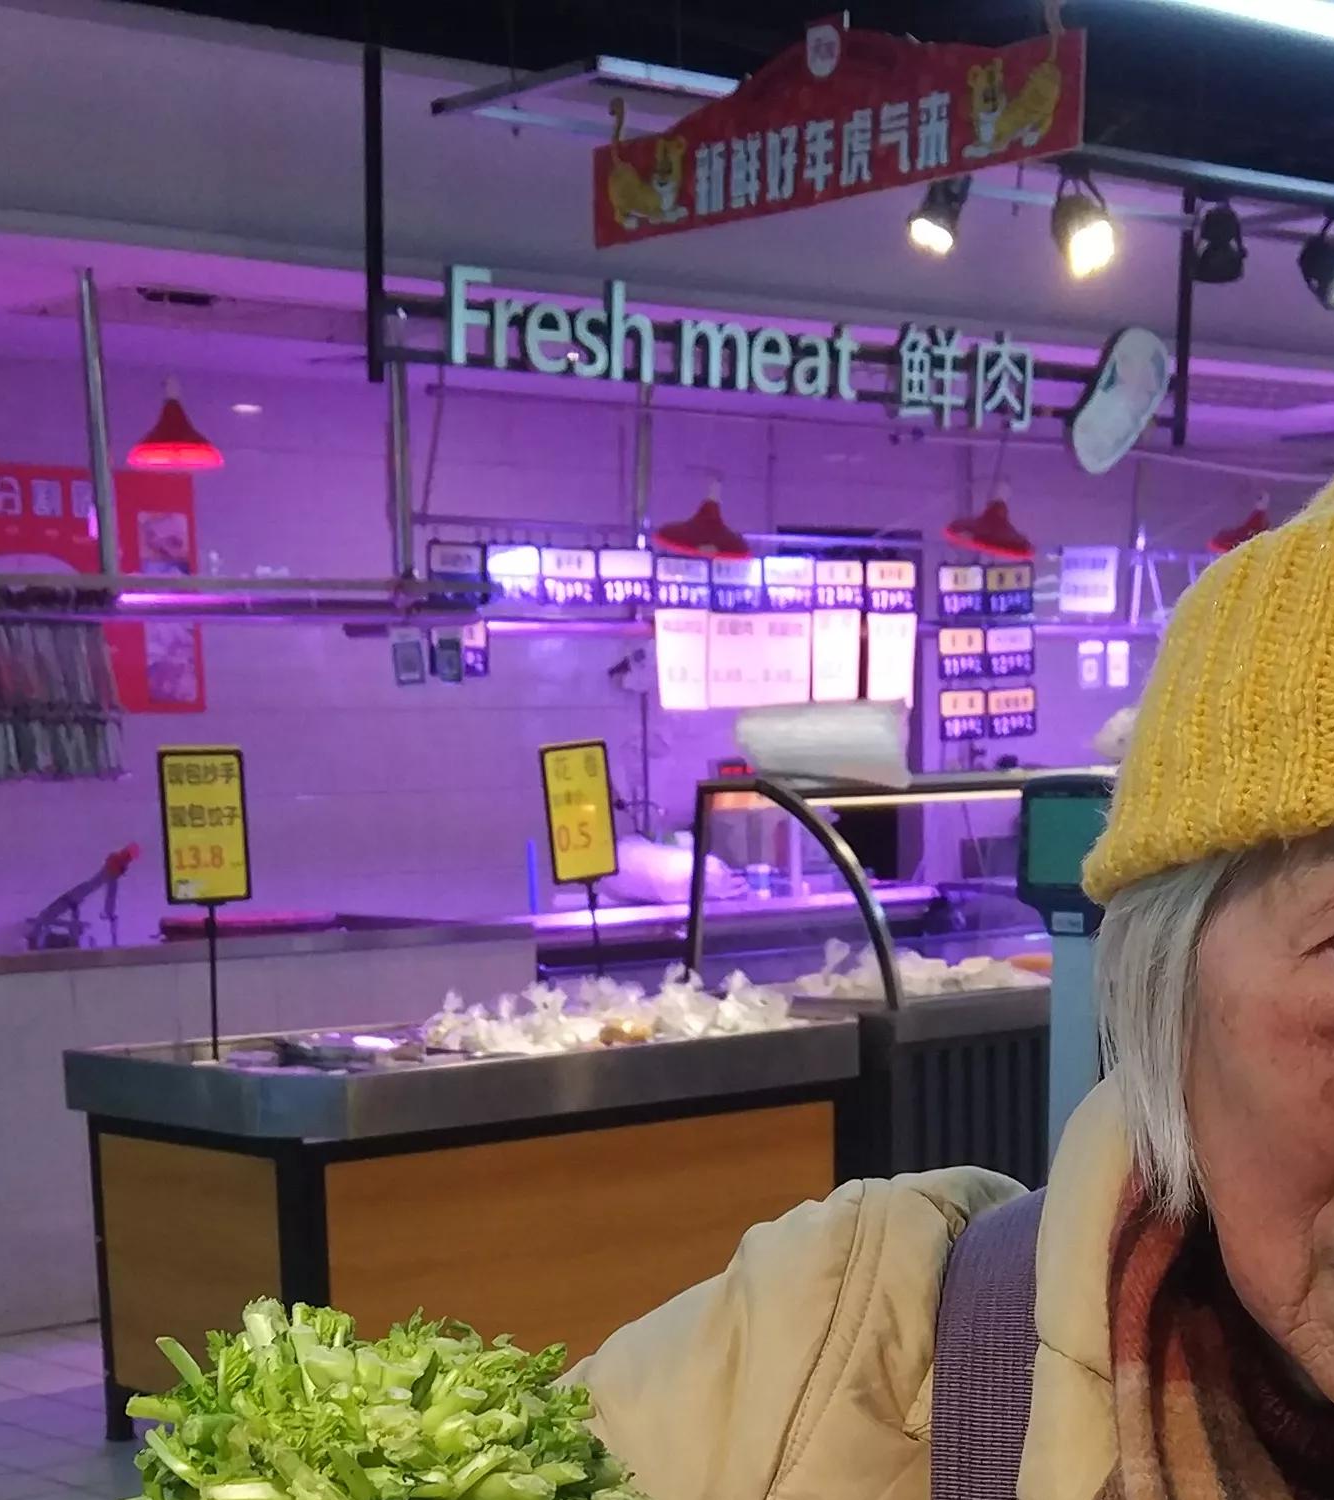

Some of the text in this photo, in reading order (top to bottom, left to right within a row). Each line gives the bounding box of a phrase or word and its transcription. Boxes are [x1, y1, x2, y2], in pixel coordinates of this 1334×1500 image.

[694, 90, 951, 216] 新鲜好年虎气来
[448, 264, 859, 400] Fresh meat
[898, 325, 1034, 432] 鲜肉
